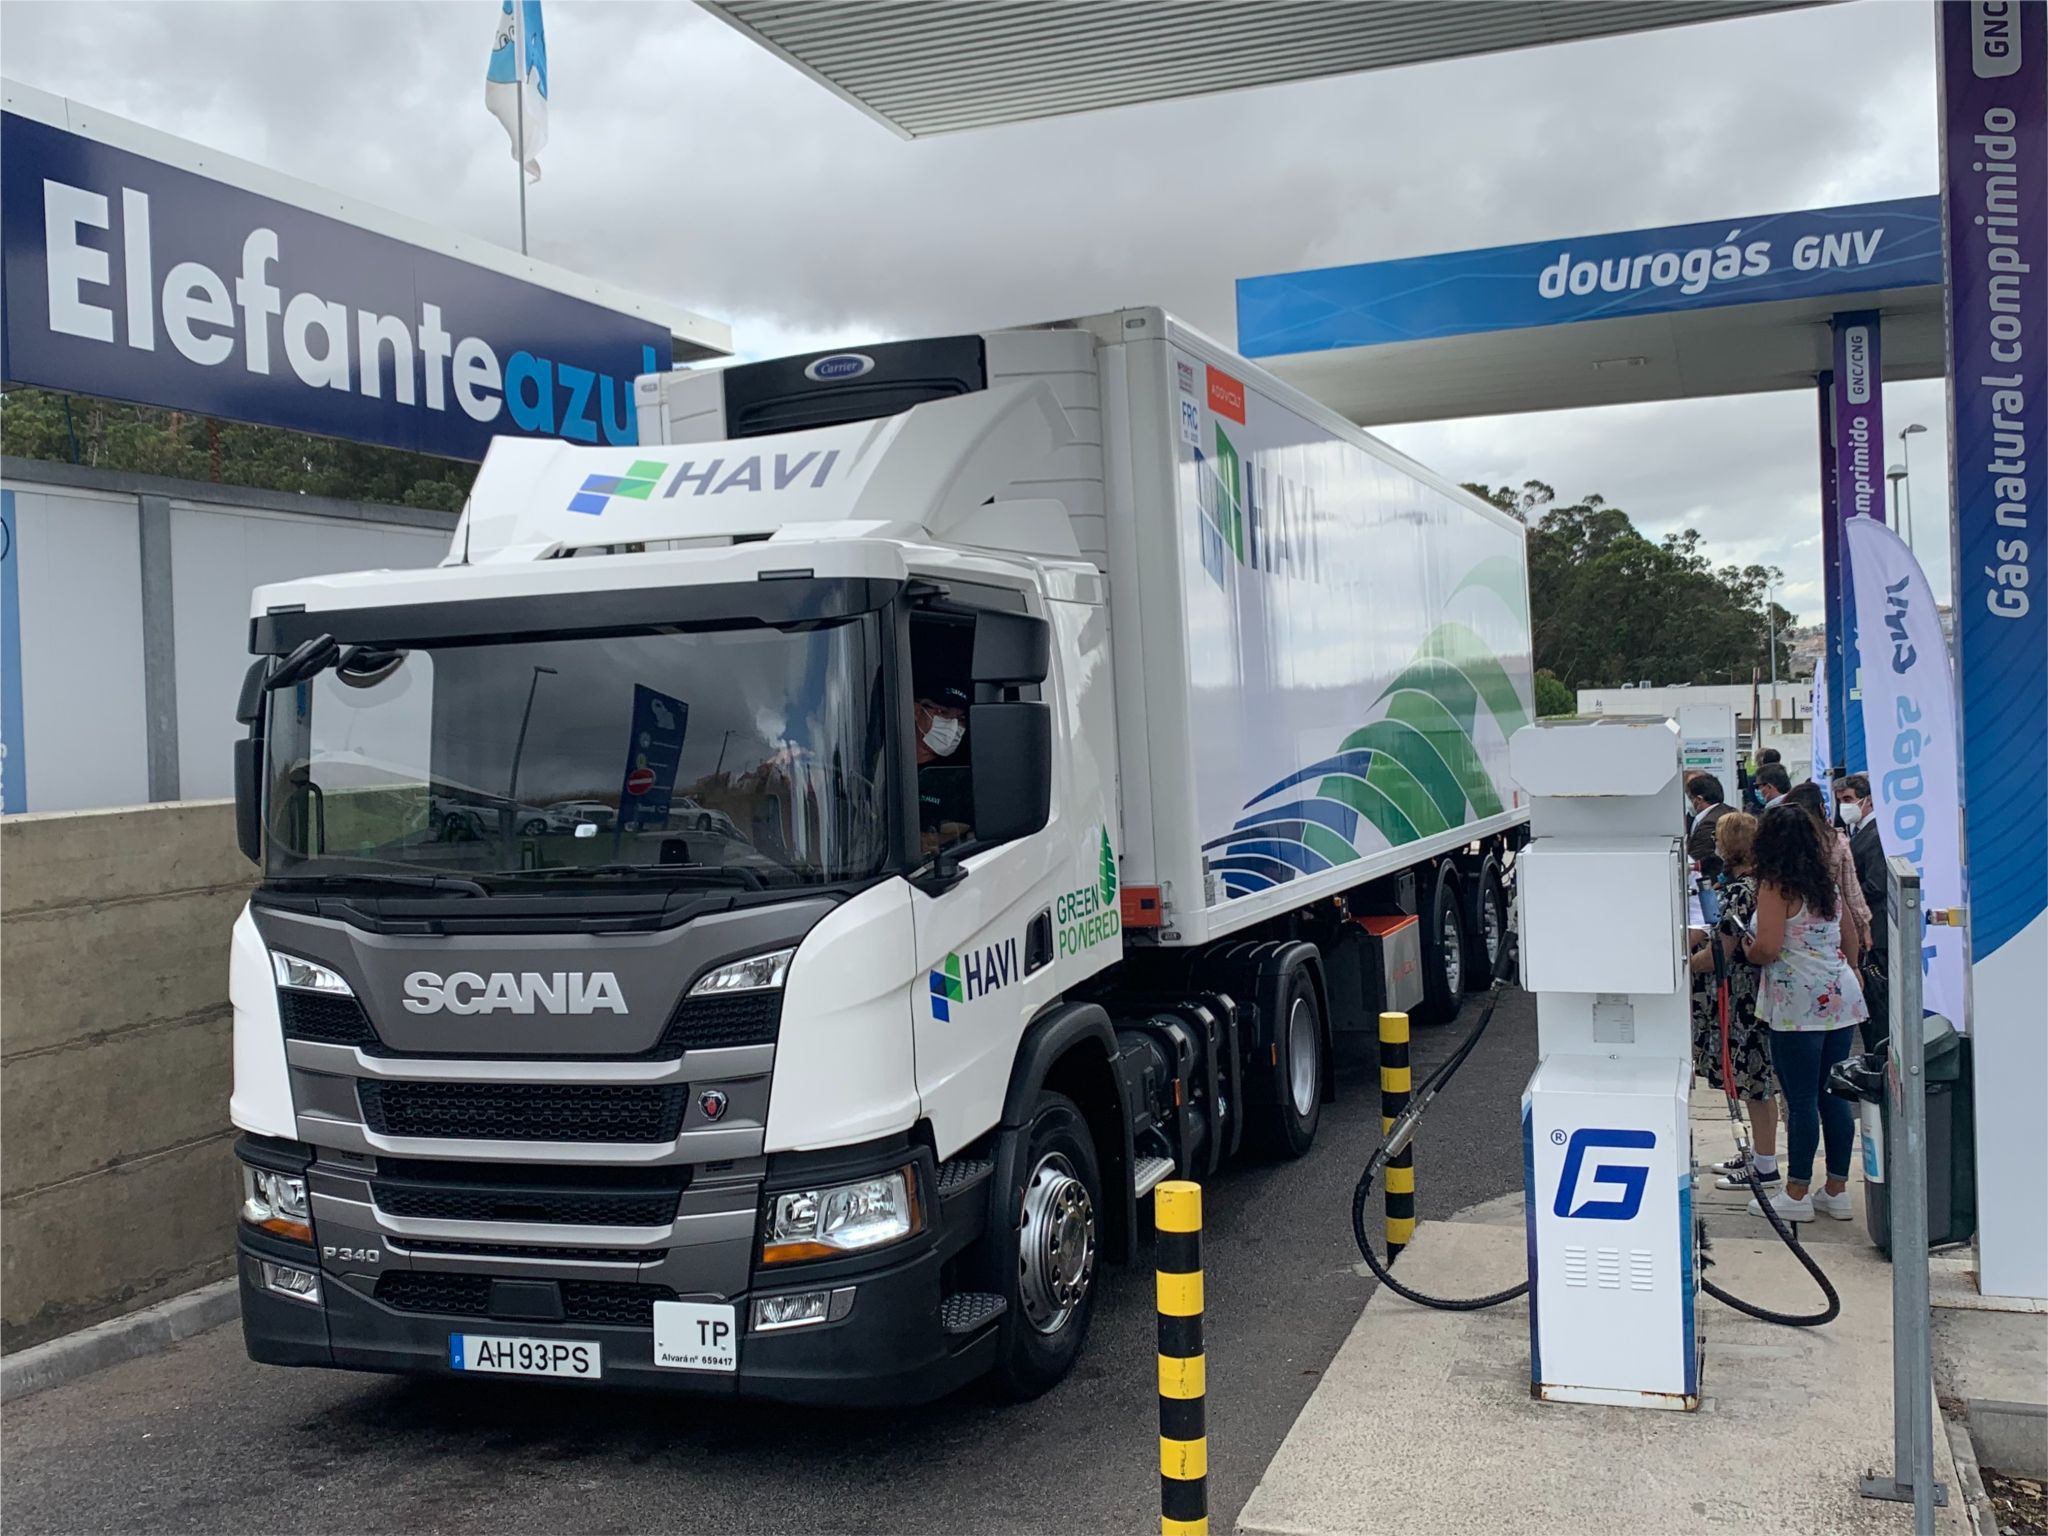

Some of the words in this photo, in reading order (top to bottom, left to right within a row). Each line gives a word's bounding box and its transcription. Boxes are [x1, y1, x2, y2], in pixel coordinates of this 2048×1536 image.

[1973, 106, 2031, 363] comprimido
[1538, 229, 1772, 299] dourogás
[1792, 228, 1886, 271] GNV
[43, 177, 656, 448] Elefanteazu
[820, 361, 858, 375] Carrier
[1851, 335, 1865, 395] GNC/CNG
[1181, 401, 1198, 431] FRC
[663, 449, 841, 500] HAVI
[1981, 374, 2029, 527] natural
[1985, 538, 2030, 619] Gás
[1057, 883, 1099, 925] GREEN
[403, 970, 629, 1014] SCANIA
[964, 937, 1019, 1001] HAVI
[661, 1352, 688, 1363] Alvará
[701, 1355, 733, 1366] 659417
[697, 1320, 730, 1347] TP
